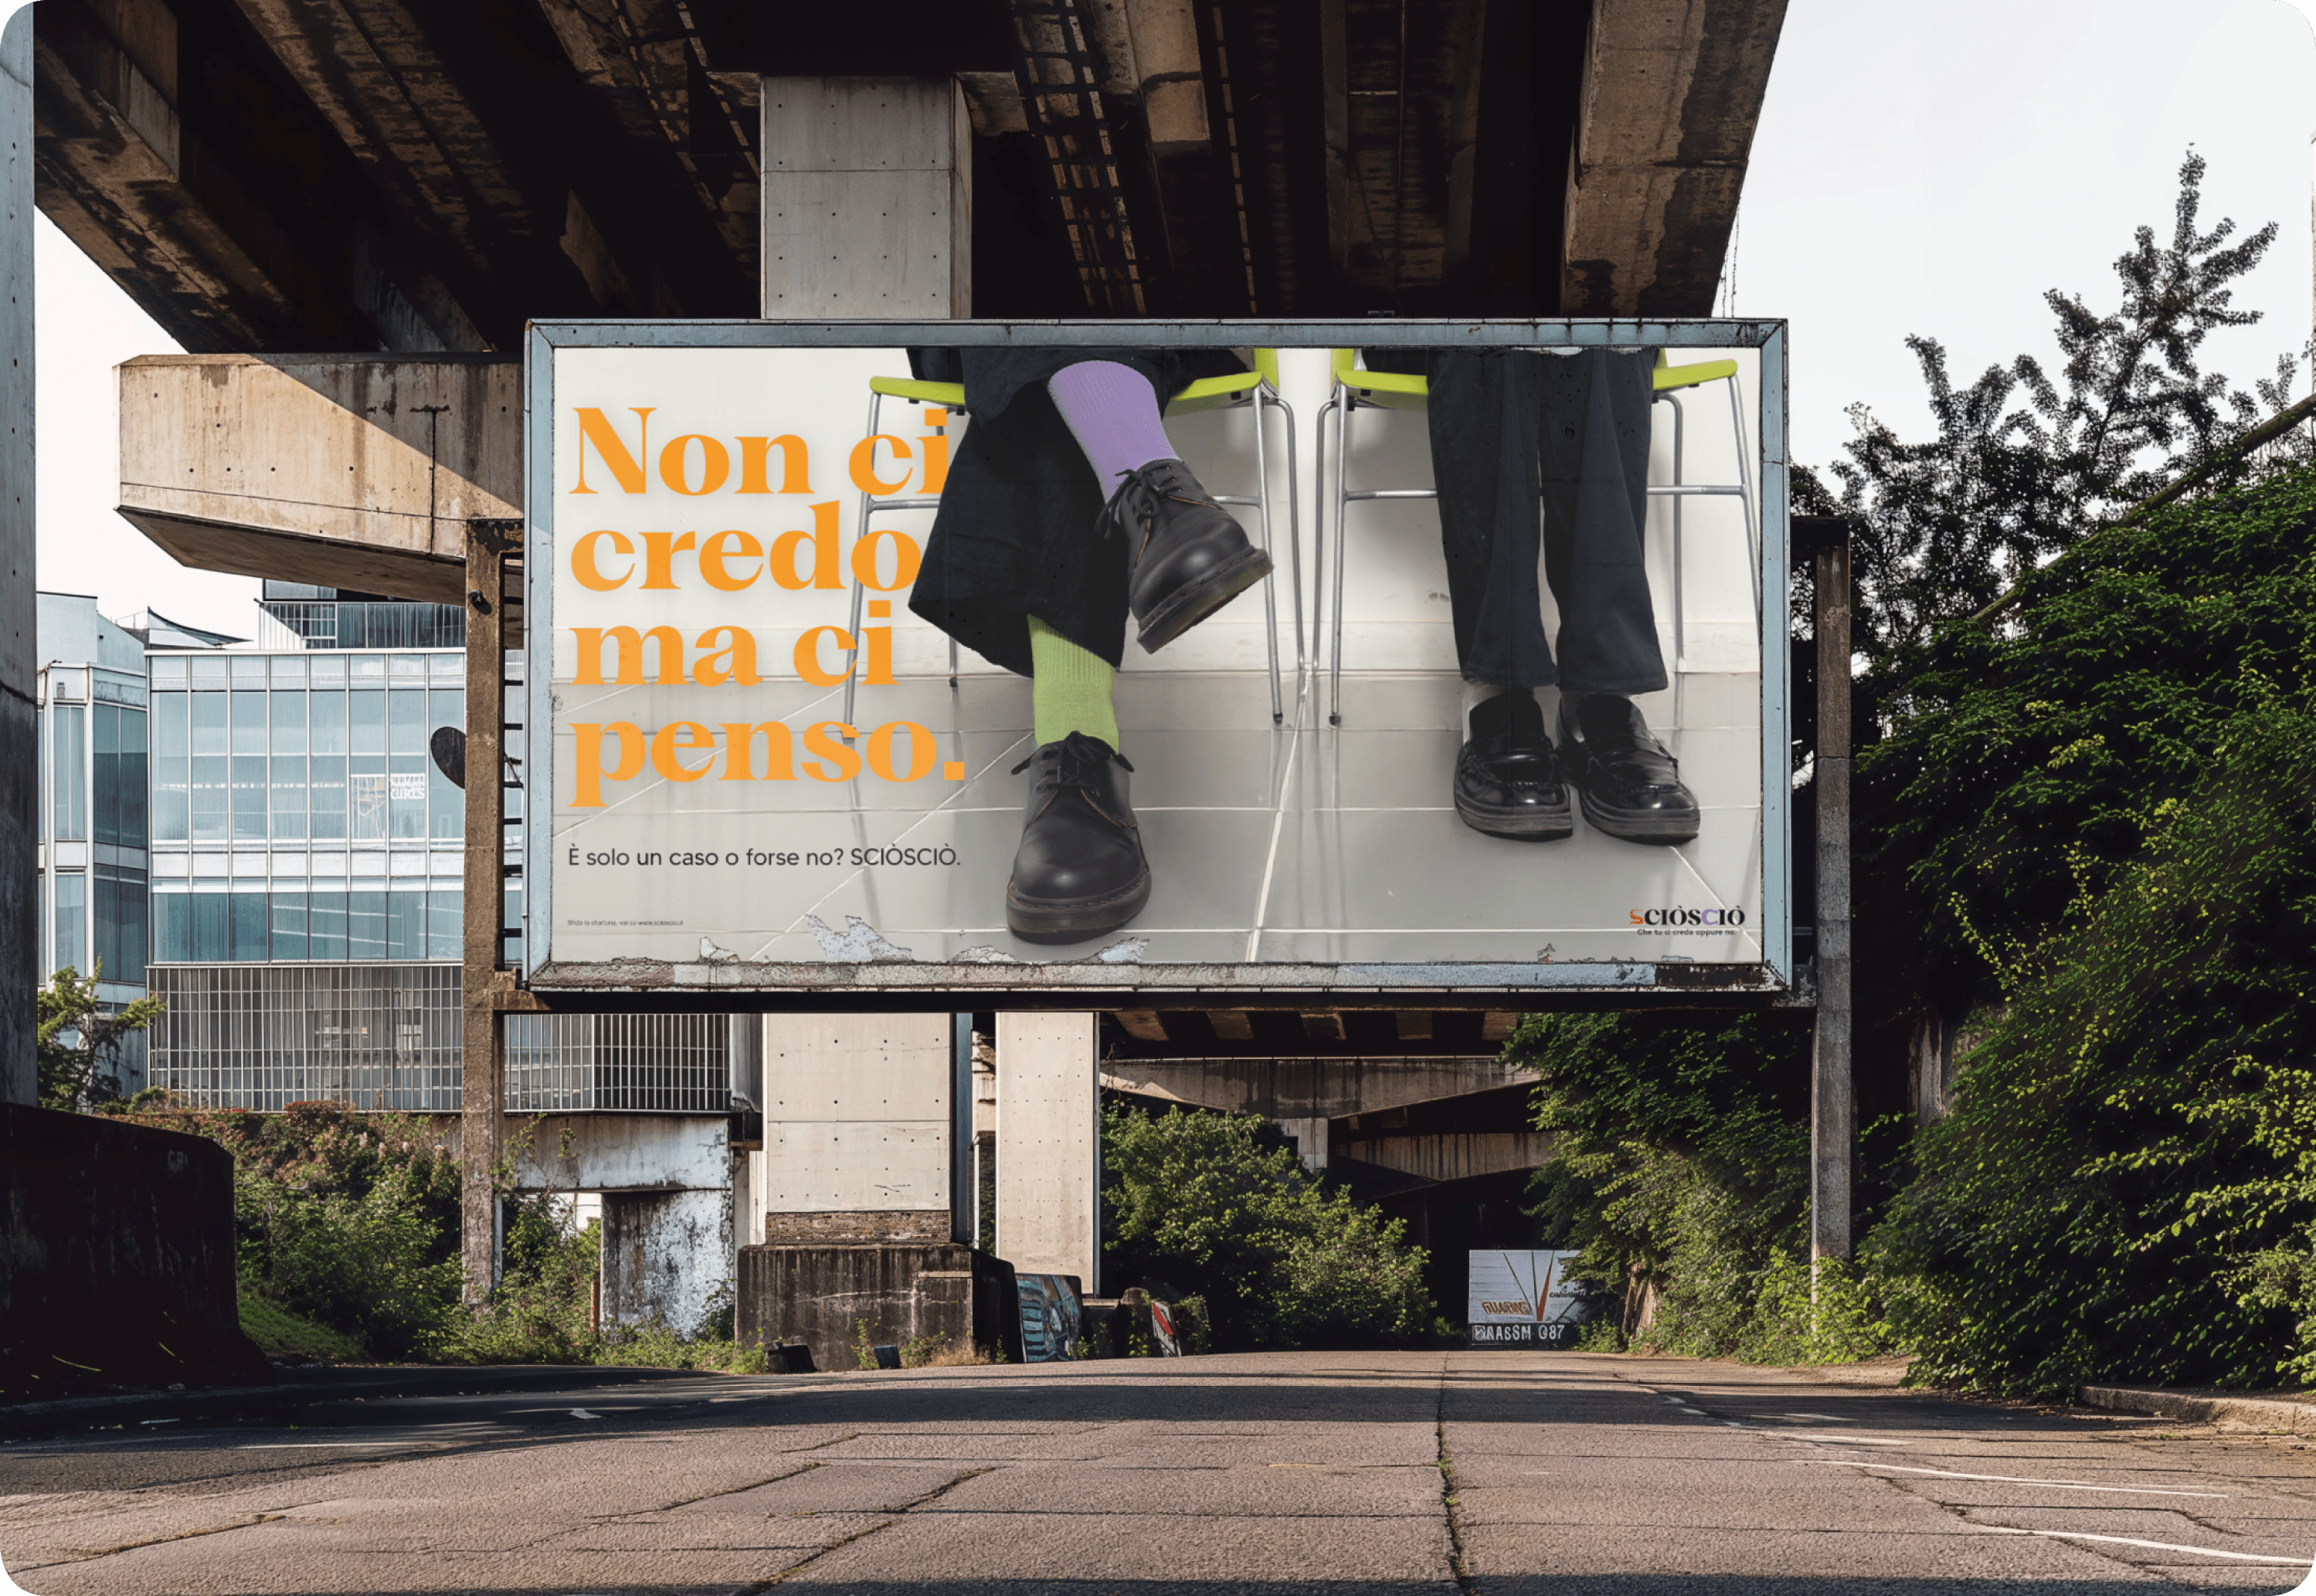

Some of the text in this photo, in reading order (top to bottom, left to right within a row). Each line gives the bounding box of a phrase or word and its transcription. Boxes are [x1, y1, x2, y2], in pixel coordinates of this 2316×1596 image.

[569, 407, 949, 496] Non ci
[570, 500, 922, 592] credo
[569, 599, 901, 688] ma ci
[568, 721, 966, 807] penso.
[569, 842, 962, 866] È solo un caso o forse no? SCIÒSCIÒ.
[1628, 905, 1746, 925] SCIÒSCIÒ
